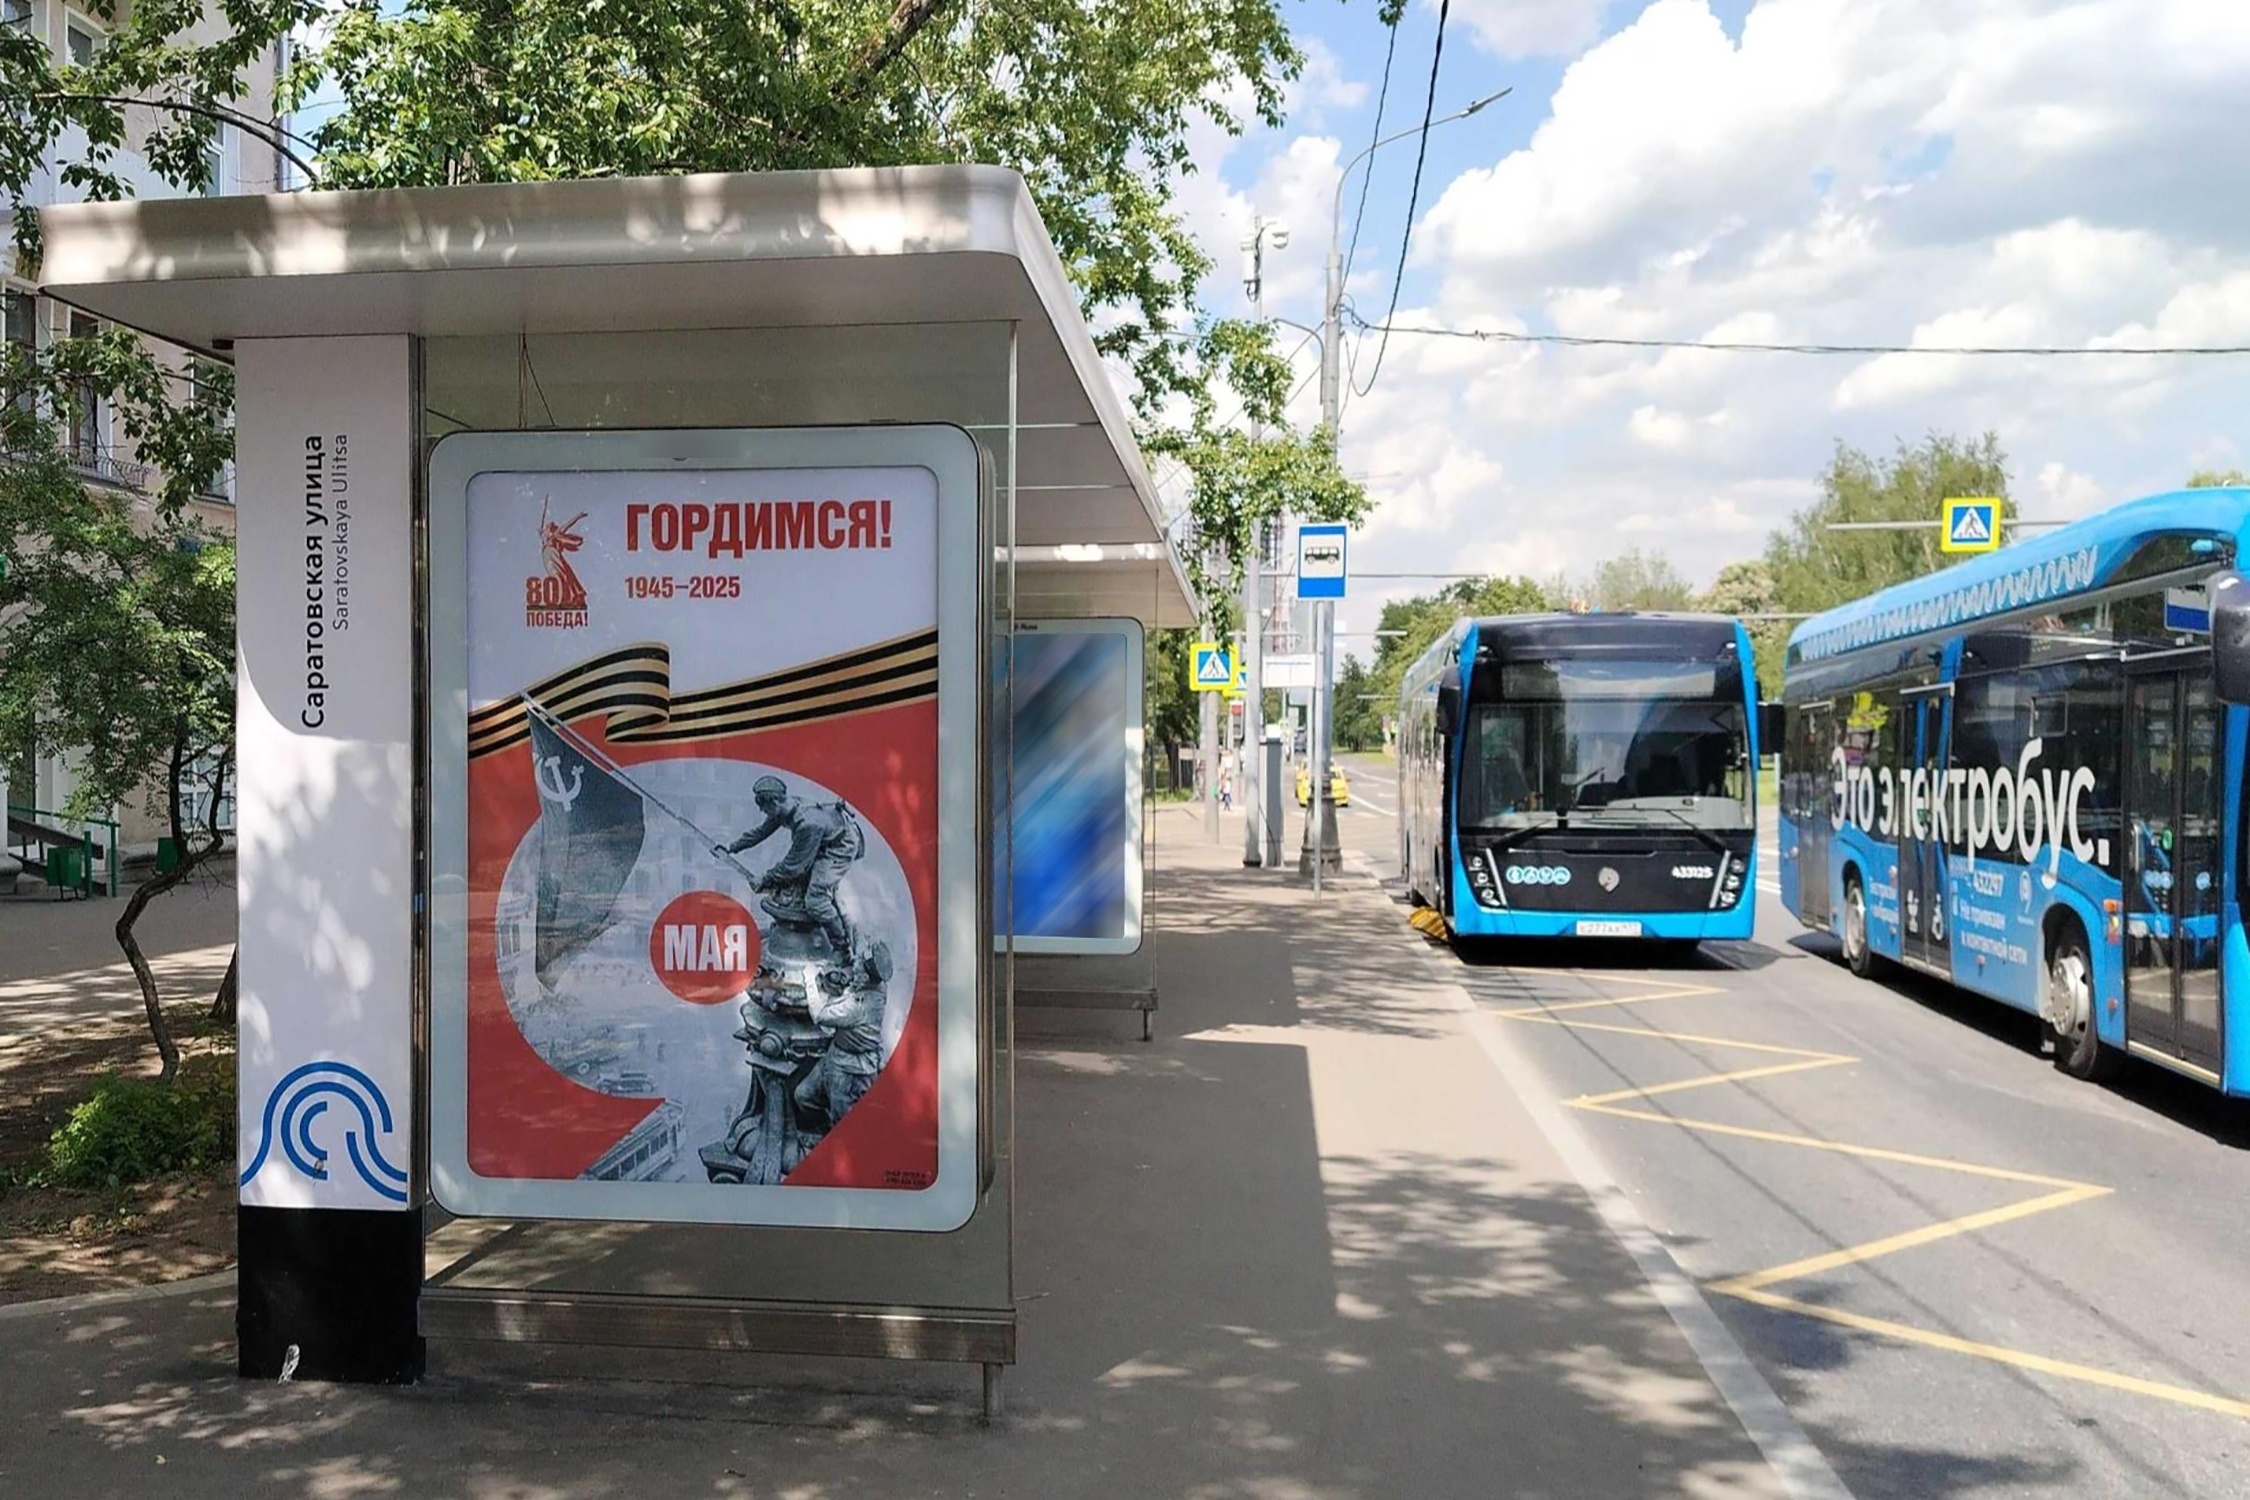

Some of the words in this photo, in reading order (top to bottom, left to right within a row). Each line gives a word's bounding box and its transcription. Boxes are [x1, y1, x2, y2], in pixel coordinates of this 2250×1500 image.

[305, 435, 328, 525] улица
[331, 434, 348, 492] Ulitsa
[332, 500, 351, 630] Saratovskaya
[626, 500, 892, 559] ГОРДИМСЯ!
[302, 535, 328, 728] Саратовская
[526, 611, 588, 629] ПОБЕДА!
[1830, 745, 1874, 833] Это
[1878, 737, 2110, 890] электробус.
[663, 924, 748, 972] МАЯ
